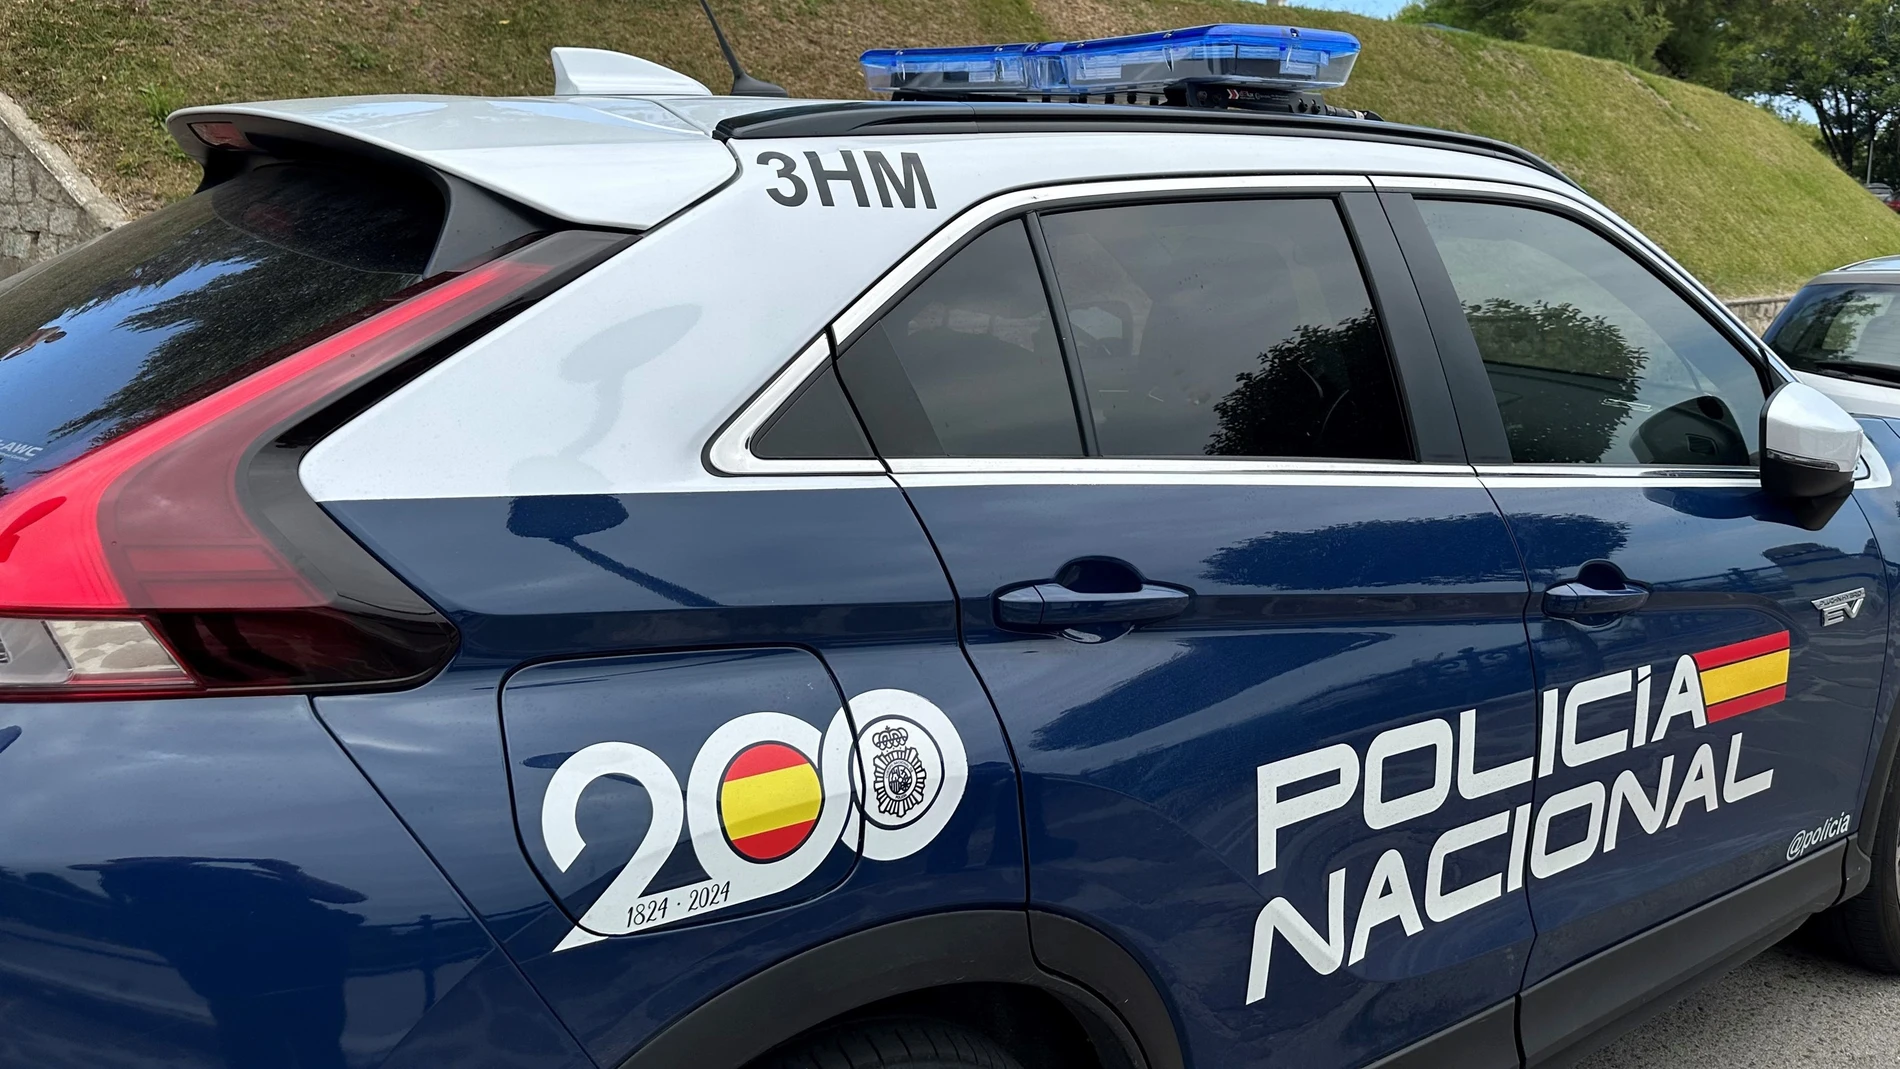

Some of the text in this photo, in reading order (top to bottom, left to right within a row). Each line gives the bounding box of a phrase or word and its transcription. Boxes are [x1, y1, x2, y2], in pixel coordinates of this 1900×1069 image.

[757, 150, 937, 209] 3HM
[1823, 598, 1864, 627] EV
[541, 688, 968, 953] 200
[1786, 811, 1851, 861] @policia
[1246, 732, 1775, 1005] NACIONAL
[627, 897, 668, 928] 1824
[687, 880, 730, 912] 2024
